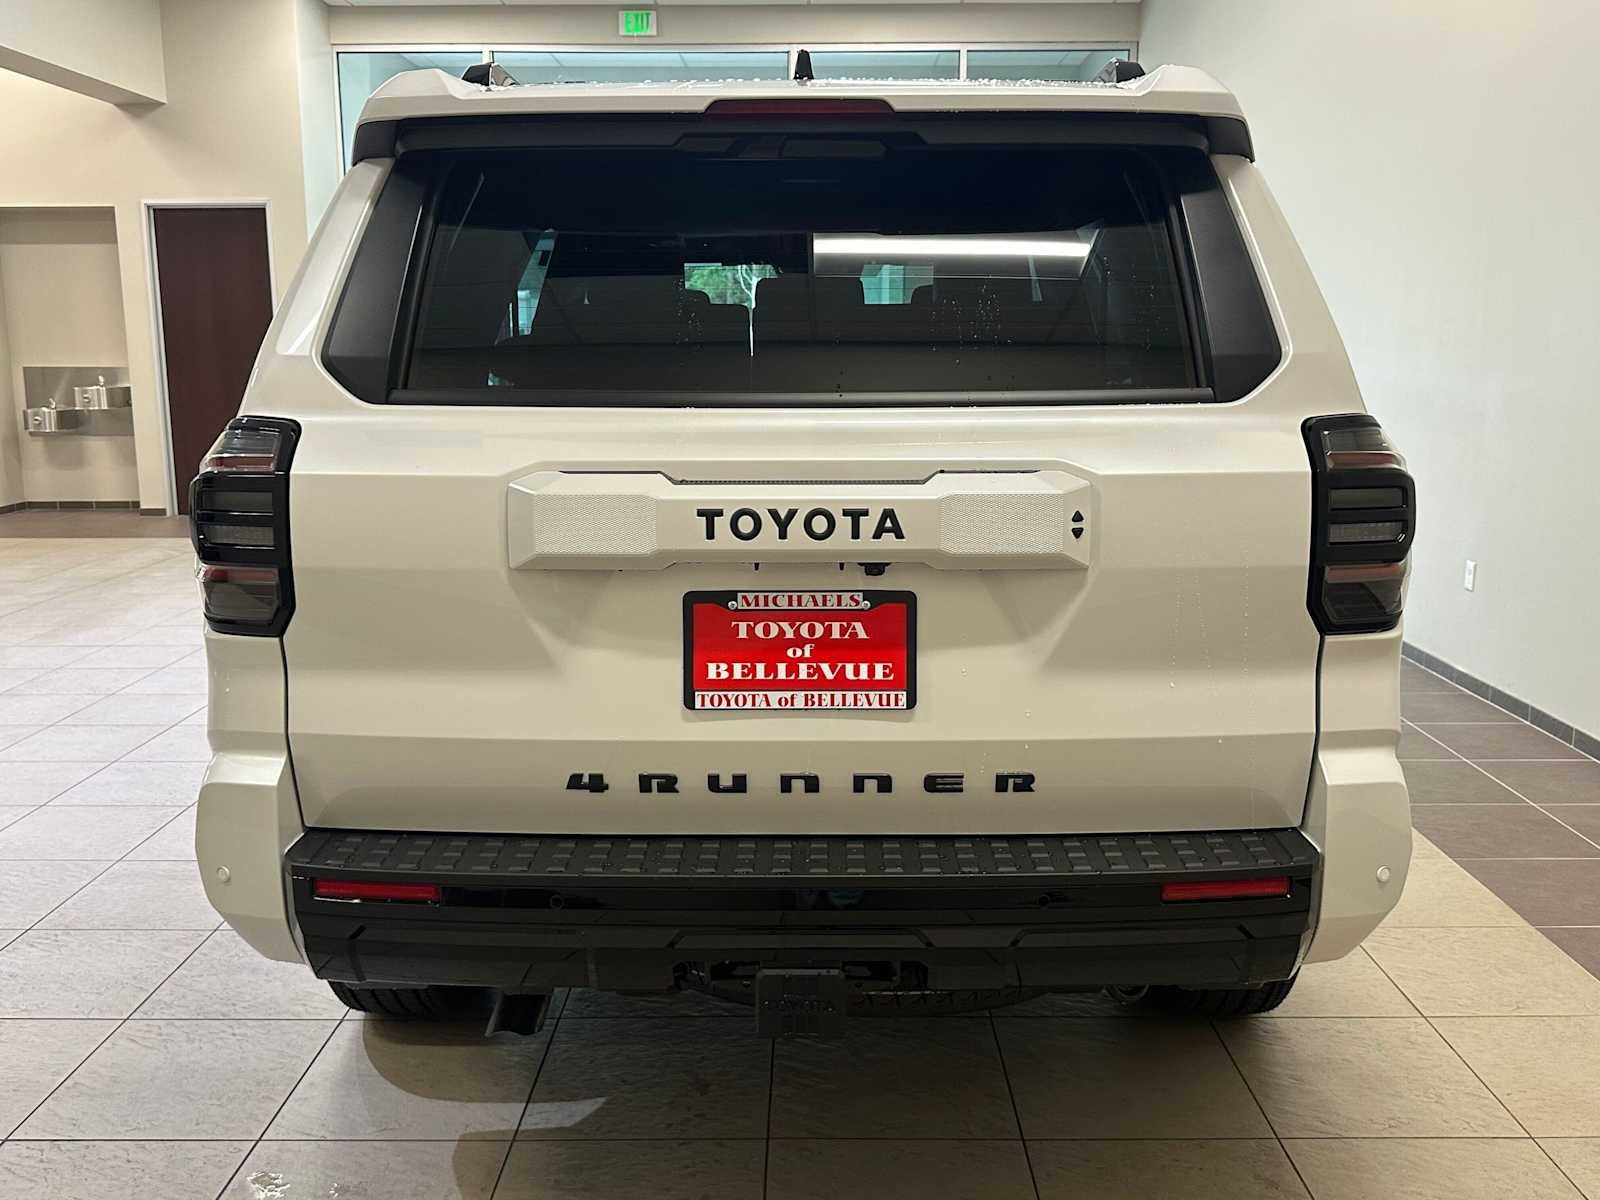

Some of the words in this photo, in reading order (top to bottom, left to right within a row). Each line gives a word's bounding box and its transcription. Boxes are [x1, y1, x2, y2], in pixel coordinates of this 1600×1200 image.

[626, 13, 651, 32] EXIT
[696, 507, 905, 541] TOYOTA
[740, 594, 862, 608] MICHAELS
[731, 621, 869, 639] TOYOTA
[786, 643, 815, 658] of
[706, 662, 895, 680] BELLEVUE
[697, 693, 771, 707] TOYOTA
[777, 693, 798, 707] of
[804, 693, 905, 707] BELLEVUE
